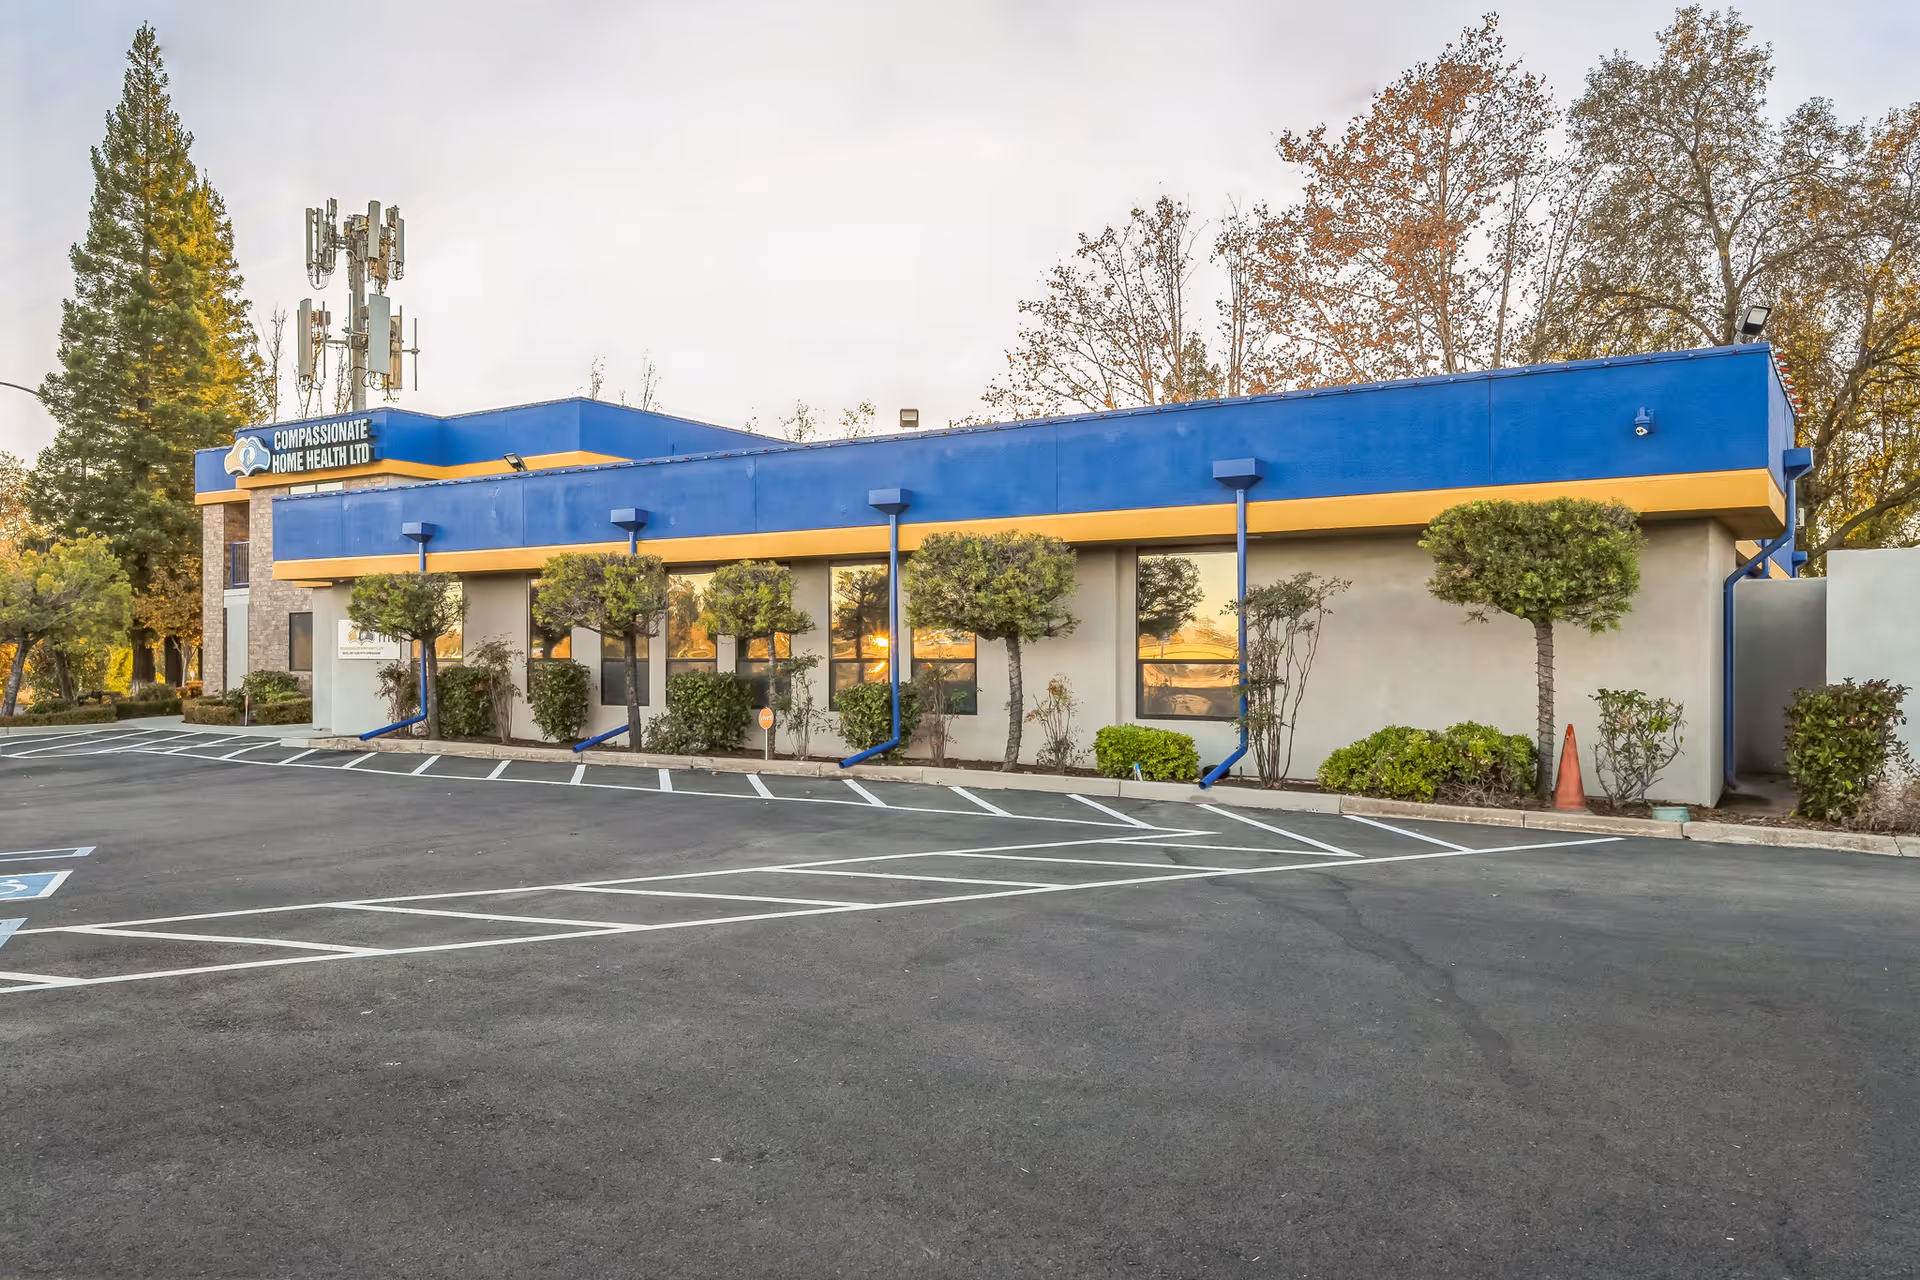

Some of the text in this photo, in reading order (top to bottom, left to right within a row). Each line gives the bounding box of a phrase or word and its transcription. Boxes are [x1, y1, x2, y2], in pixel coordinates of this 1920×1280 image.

[274, 419, 368, 450] COMPASSIONATE
[272, 443, 370, 474] HOME HEALTH LTD
